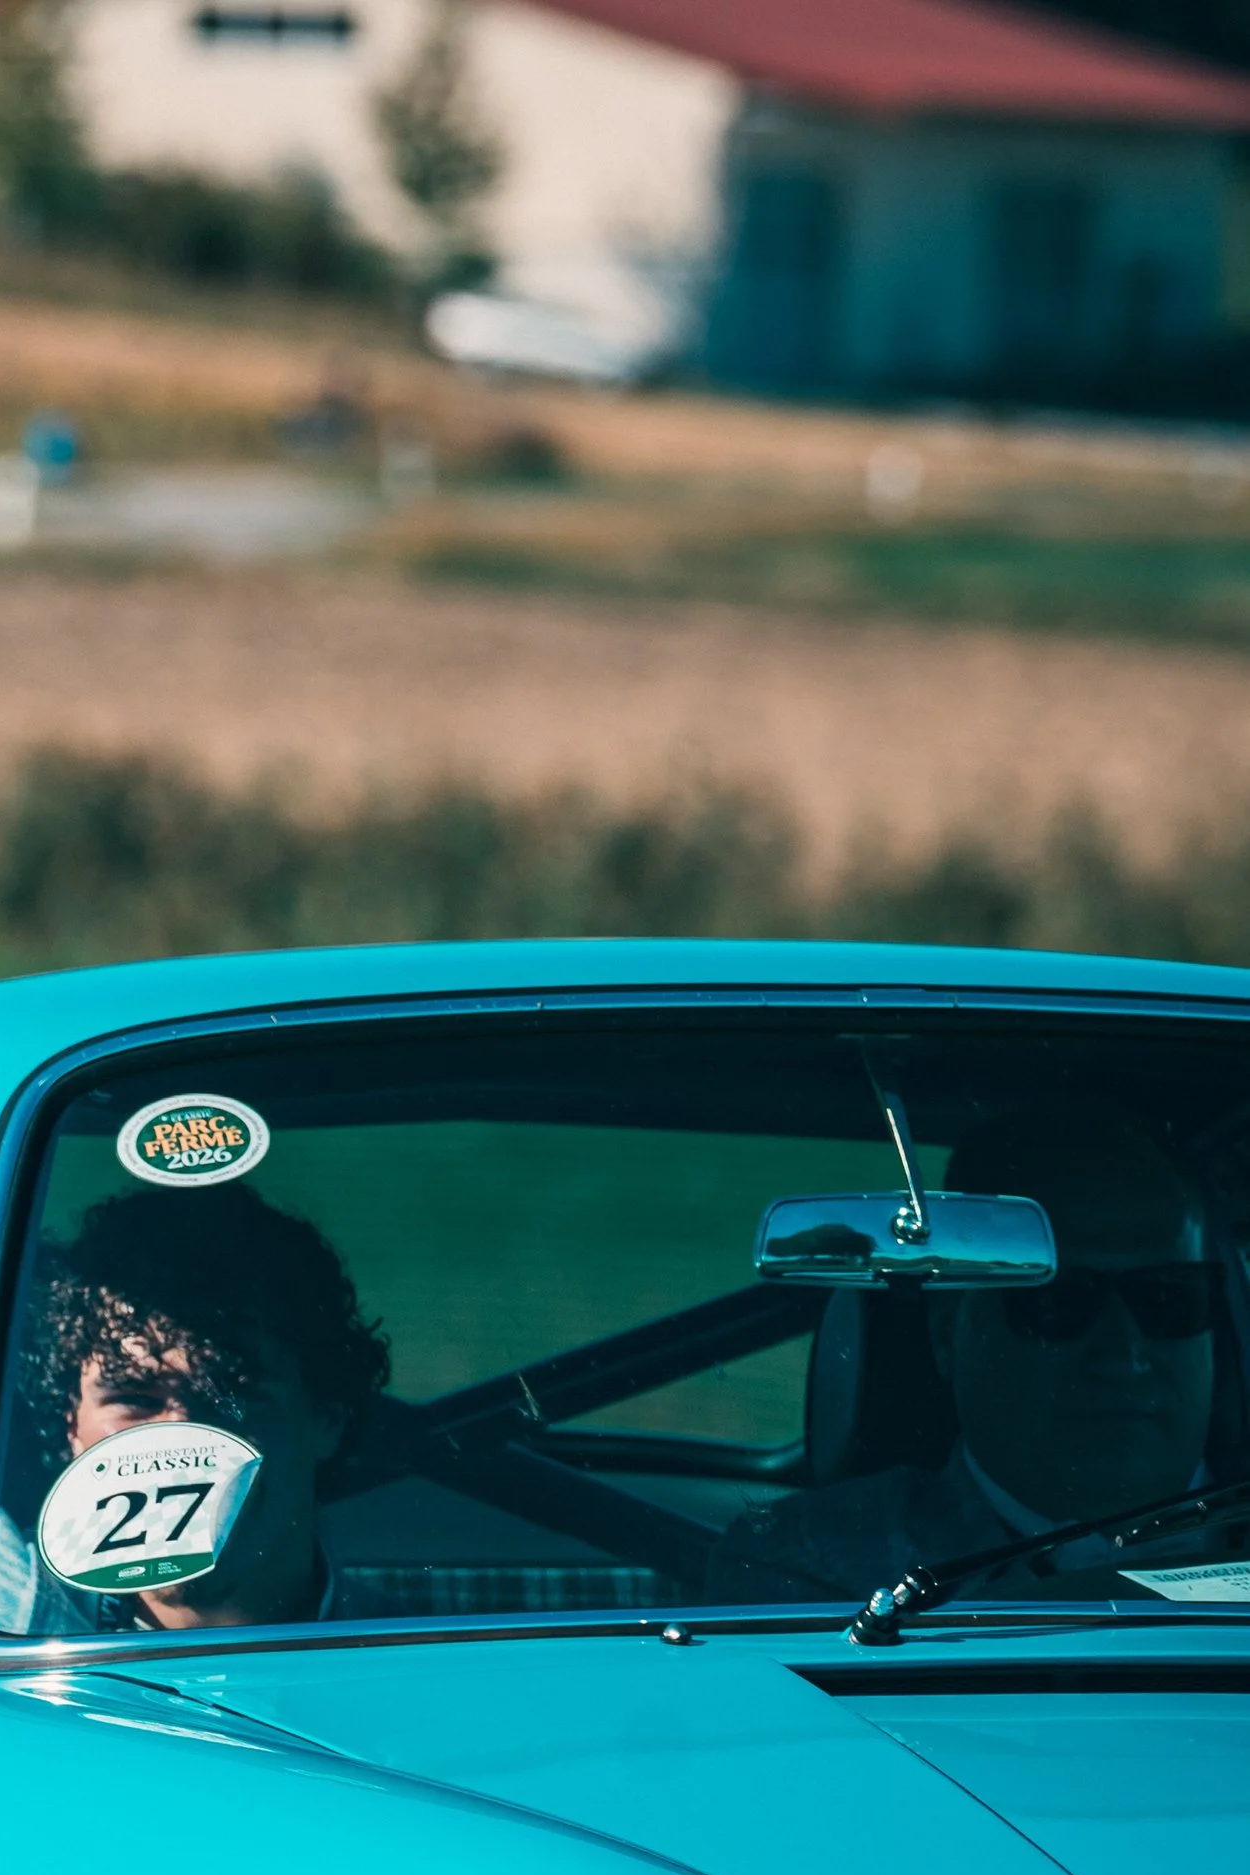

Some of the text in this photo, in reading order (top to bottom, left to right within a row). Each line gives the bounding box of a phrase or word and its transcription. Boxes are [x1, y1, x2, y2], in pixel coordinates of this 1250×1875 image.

[153, 1116, 228, 1141] PARC
[164, 1146, 233, 1170] 2026
[117, 1445, 219, 1464] FUGGERSTADT
[117, 1454, 218, 1477] CLASSIC
[92, 1482, 216, 1555] 27
